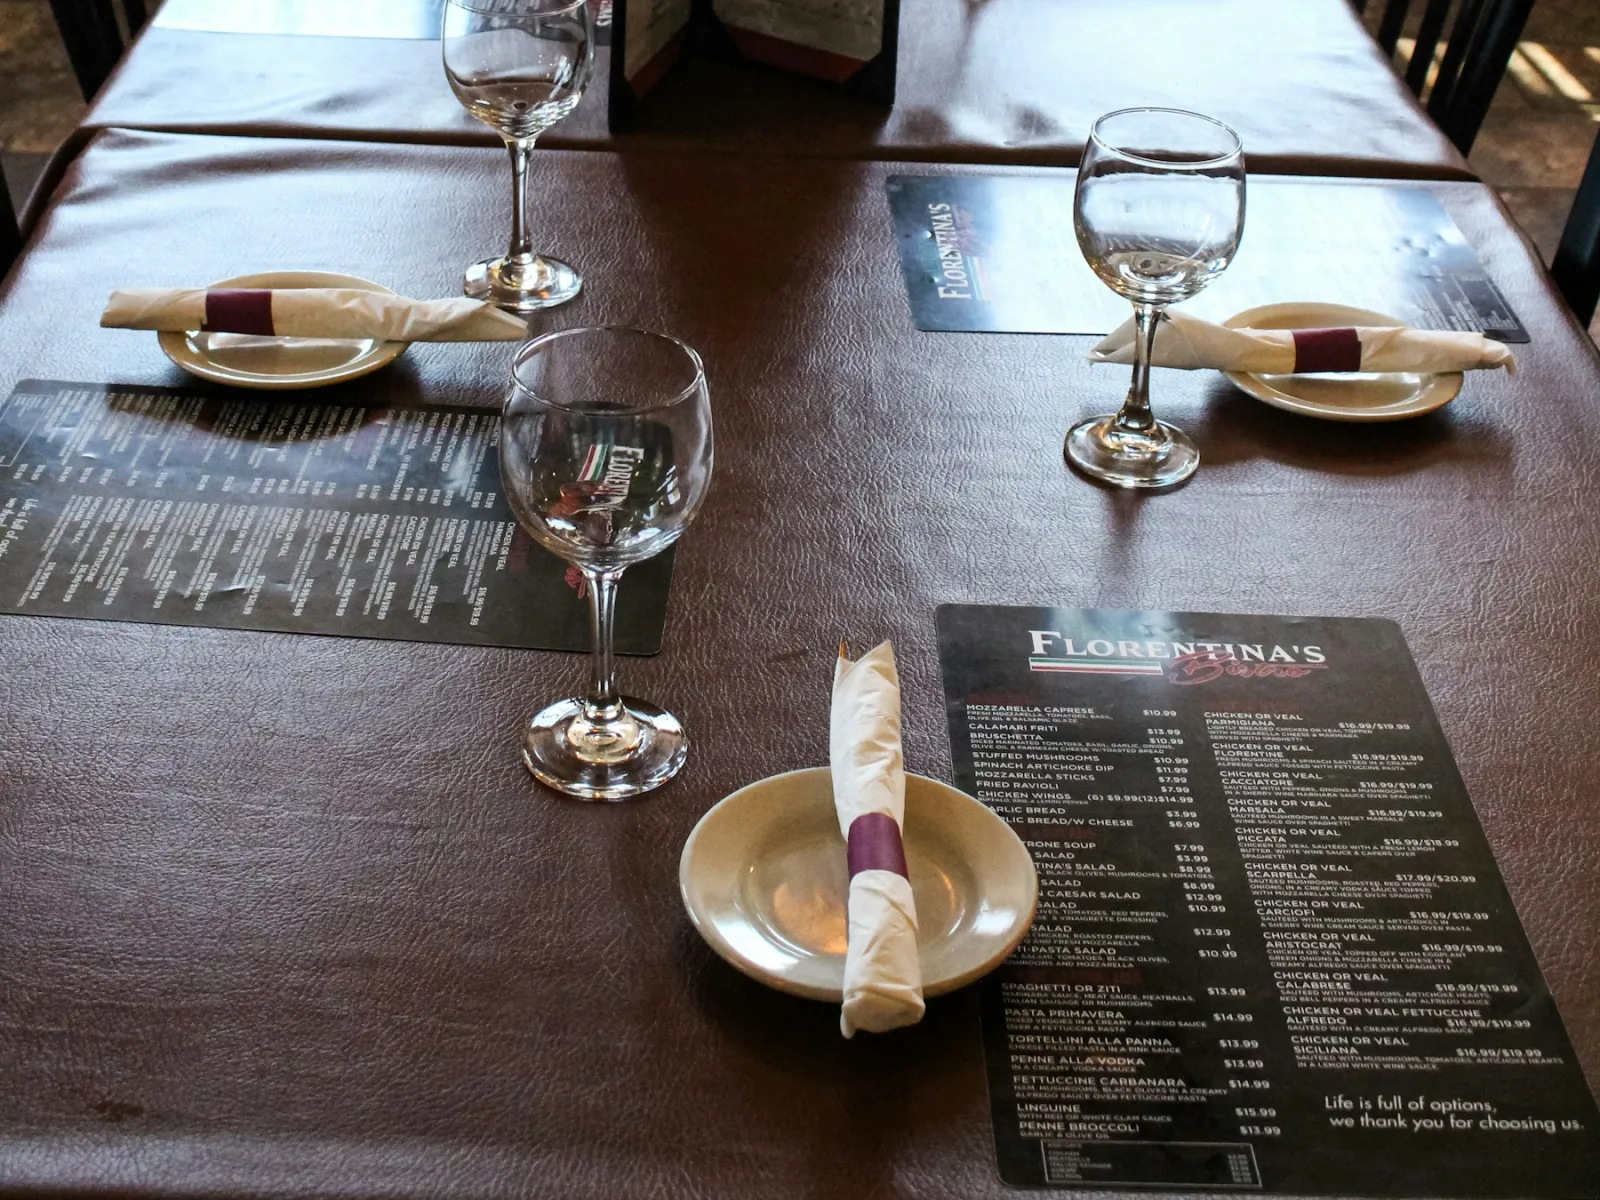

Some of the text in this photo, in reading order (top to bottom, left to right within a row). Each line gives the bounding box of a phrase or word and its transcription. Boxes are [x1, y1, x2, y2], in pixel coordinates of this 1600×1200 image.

[928, 203, 972, 299] FLORENTINA'S
[1028, 630, 1326, 664] FLORENTINA'S
[966, 705, 1040, 713] MOZZARELLA
[1044, 706, 1094, 714] CAPRESE
[1206, 719, 1410, 730] PARMIGIANA $16.99/$19.99
[1214, 750, 1284, 758] FLORENTINE
[1026, 763, 1092, 771] ARTICHOKE
[975, 771, 1053, 780] MOZZARELLA
[1013, 782, 1059, 790] RAVIOLI
[1221, 778, 1294, 786] CACCIATORE
[978, 791, 1028, 799] CHICKEN
[1087, 794, 1104, 802] (6)
[988, 806, 1024, 814] ARLIC
[1229, 806, 1286, 814] MARSALA
[1089, 819, 1133, 827] CHEESE
[1235, 827, 1286, 835] CHICKEN
[1320, 864, 1353, 872] VEAL
[1247, 871, 1476, 883] SCARPELLA $17.99/$20.99
[1183, 882, 1215, 890] $8.99
[1186, 893, 1222, 901] $12.99
[1254, 900, 1308, 908] CHICKEN
[1332, 901, 1364, 909] VEAL
[1256, 908, 1489, 920] CARCIOFI $16.99/$19.99
[1263, 932, 1317, 940] CHICKEN
[1321, 933, 1339, 941] OR
[1074, 947, 1116, 955] SALAD
[1198, 950, 1237, 958] $10.99
[1266, 941, 1503, 953] ARISTOCRAT $16.99/$19.99
[1274, 971, 1330, 980] CHICKEN
[1354, 973, 1388, 981] VEAL
[1001, 983, 1071, 992] SPAGHETTI
[1096, 985, 1121, 993] ZITI
[1207, 987, 1245, 996] $13.99
[1276, 981, 1518, 993] CALABRESE $16.99/$19.99
[1005, 1009, 1253, 1022] PASTA PRIMAVERA $14.99
[1283, 1006, 1481, 1018] CHICKEN OR VEAL FETTUCCINE
[1008, 1035, 1259, 1049] TORTELLINI ALLA PANNA $13.99
[1290, 1035, 1409, 1046] CHICKEN OR VEAL
[1011, 1055, 1264, 1068] PENNE ALLA VODKA $13.99
[1013, 1076, 1270, 1089] FETTUCCINE CARBANARA $14.99
[1017, 1103, 1276, 1117] LINGUINE $15.99
[1325, 1096, 1497, 1114] Life is full of options,
[1019, 1122, 1281, 1135] PENNE BROCCOLI $13.99
[1330, 1114, 1585, 1133] we thank you for choosing us.
